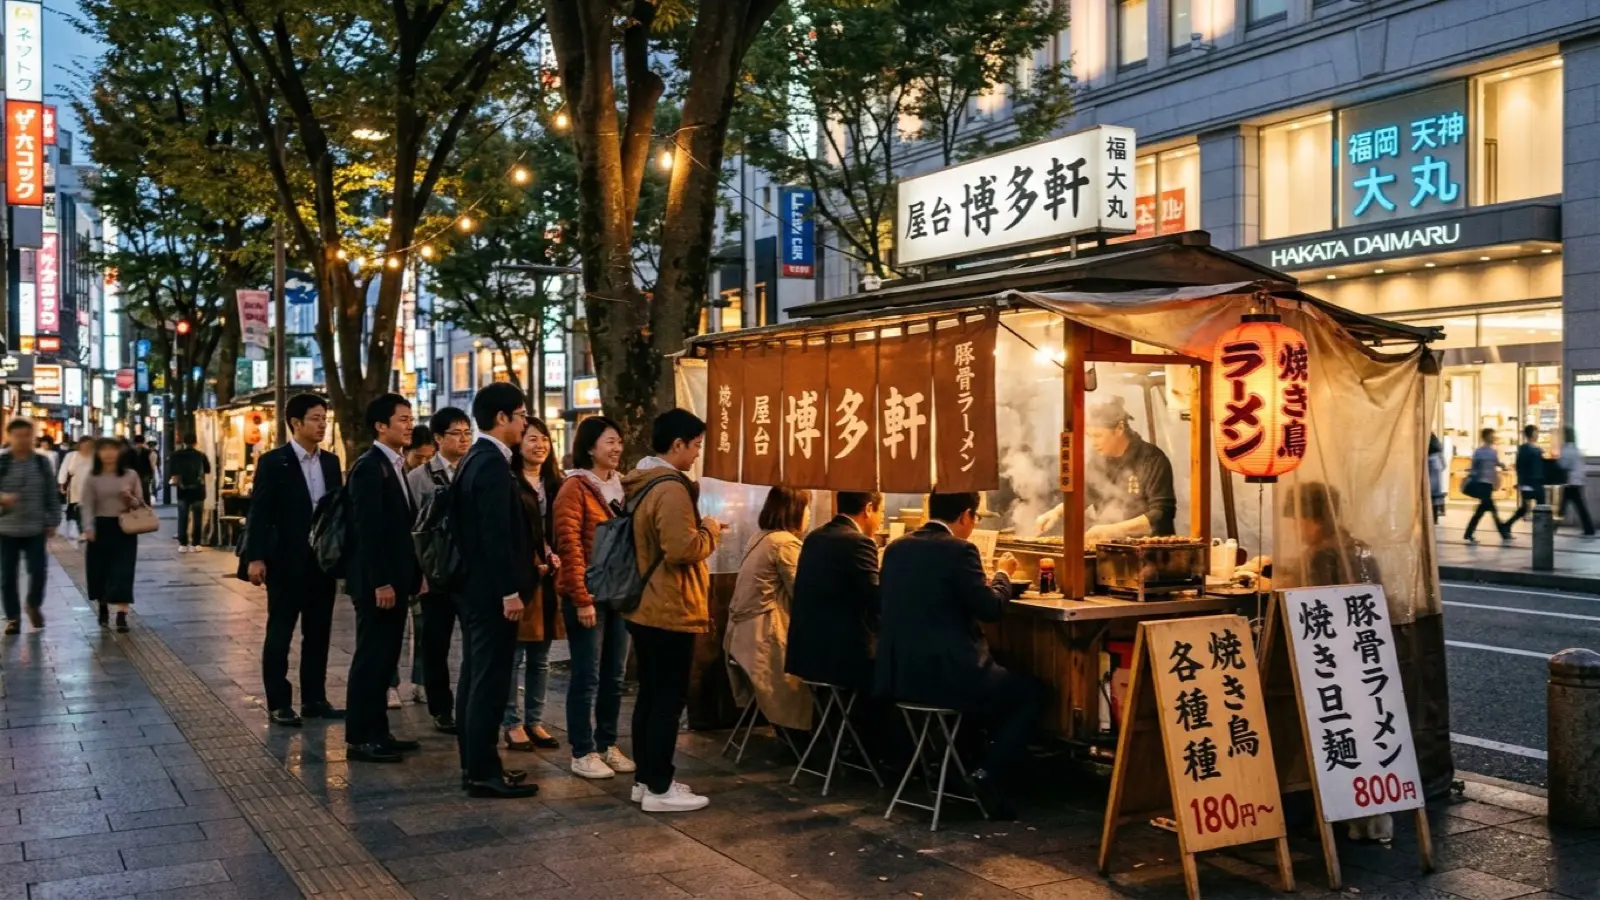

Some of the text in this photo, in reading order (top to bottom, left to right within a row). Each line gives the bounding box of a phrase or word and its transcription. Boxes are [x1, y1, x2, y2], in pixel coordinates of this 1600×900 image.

[1106, 136, 1128, 219] 福大丸
[1348, 111, 1465, 164] 福岡 天神
[905, 196, 952, 240] 屋台
[960, 157, 1090, 238] 博多軒
[1353, 155, 1459, 217] 大丸
[1271, 223, 1460, 268] HAKATA DAIMARU
[751, 395, 771, 456] 屋台
[785, 386, 927, 460] 博多軒
[953, 340, 976, 473] 豚骨ラーメン
[1222, 340, 1266, 460] ラーメン
[1277, 340, 1309, 460] 焼き鳥
[1167, 640, 1222, 783] 各種種
[1208, 628, 1260, 758] 焼き鳥
[1343, 592, 1403, 769] 豚骨ラーメン
[1353, 772, 1417, 808] 800円
